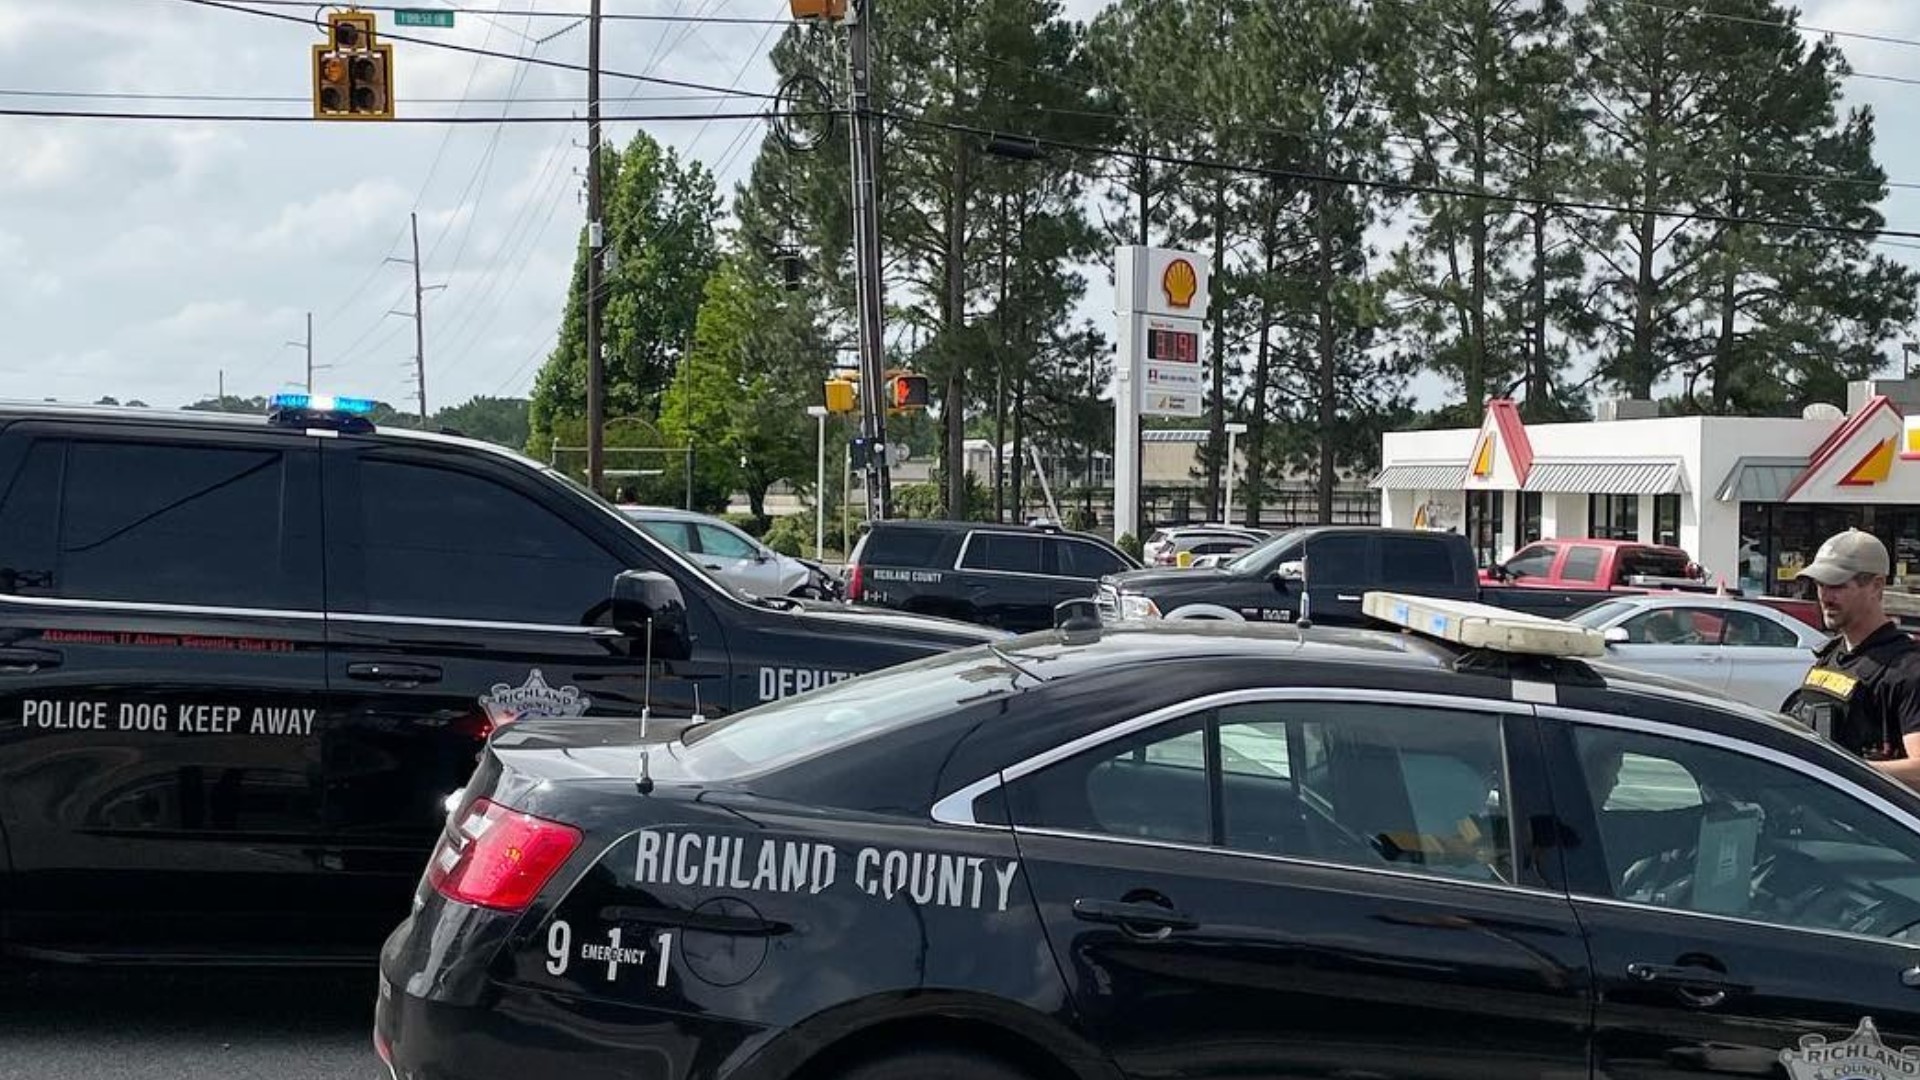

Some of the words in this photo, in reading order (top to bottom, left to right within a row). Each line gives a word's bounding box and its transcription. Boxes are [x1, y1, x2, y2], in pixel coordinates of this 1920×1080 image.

[912, 571, 943, 583] COUNTY
[498, 688, 572, 705] RICHLAND
[22, 700, 107, 730] POLICE
[119, 703, 168, 731] DOG
[178, 705, 242, 733] KEEP
[250, 707, 317, 735] AWAY
[634, 829, 837, 894] RICHLAND
[855, 847, 1018, 911] COUNTY
[581, 943, 647, 965] EMERGENCY
[1807, 1044, 1915, 1074] RICHLAND
